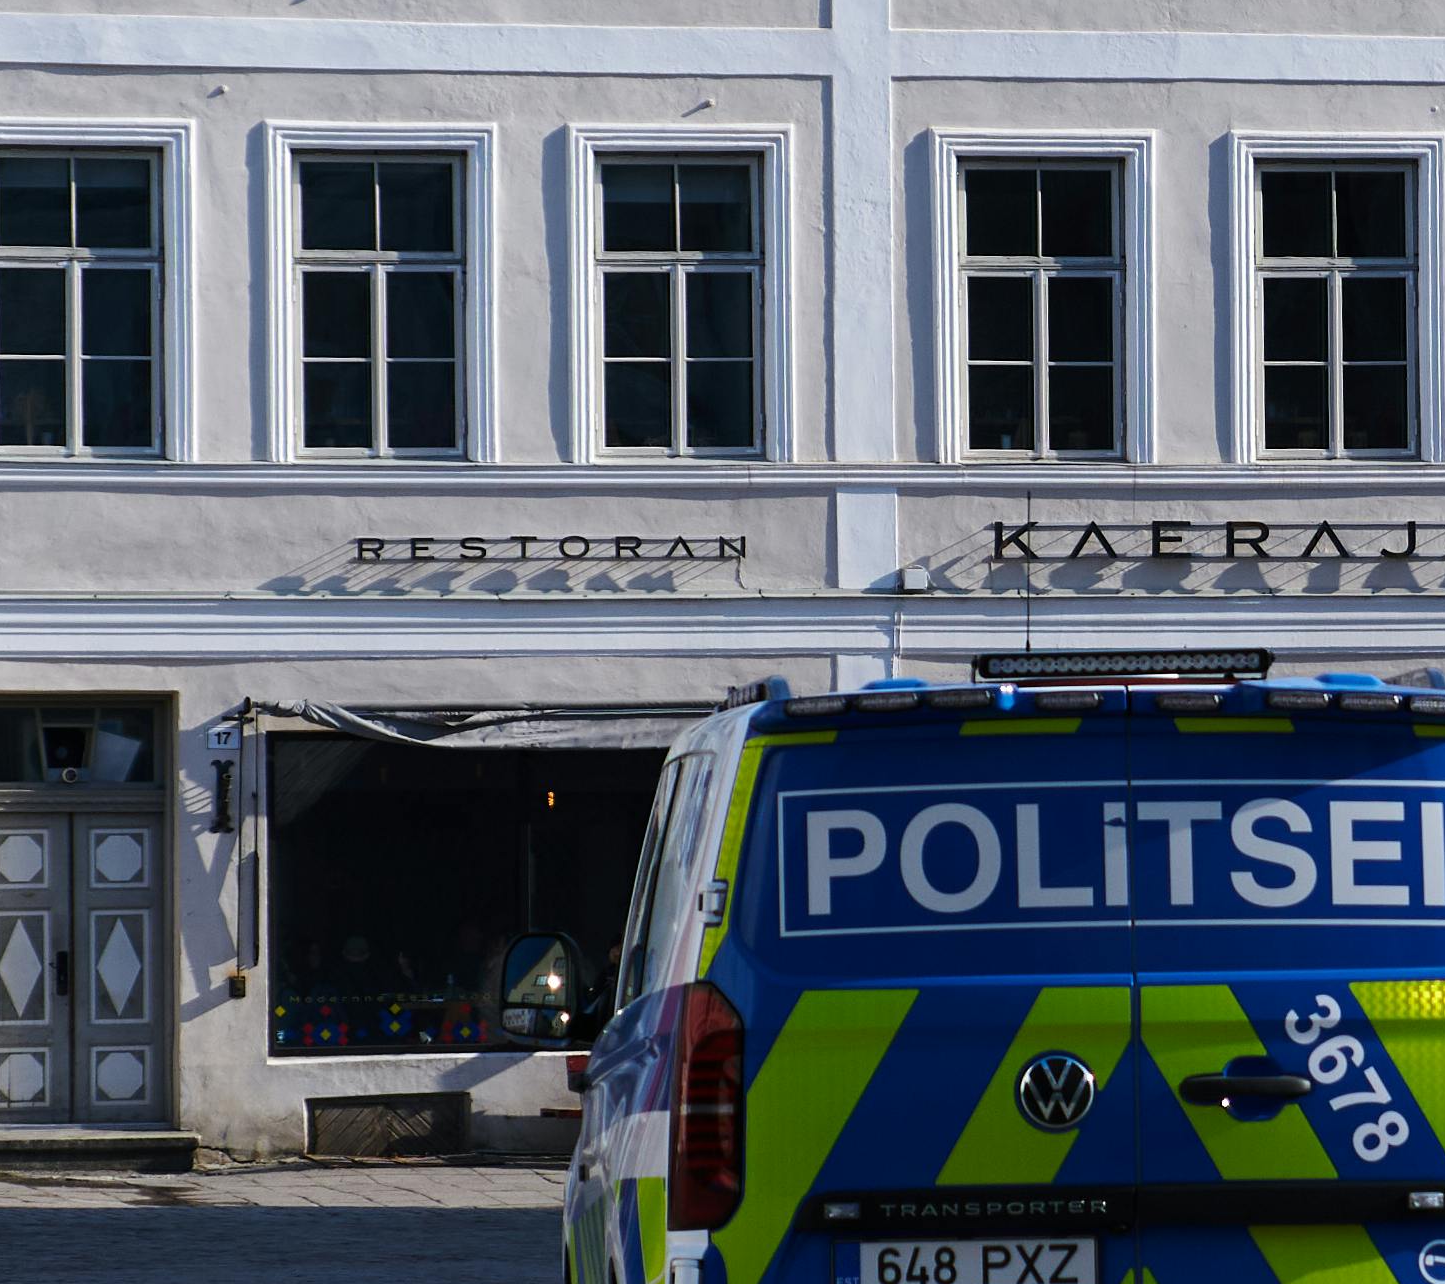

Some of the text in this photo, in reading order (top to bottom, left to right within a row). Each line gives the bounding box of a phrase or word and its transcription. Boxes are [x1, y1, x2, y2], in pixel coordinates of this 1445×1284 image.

[357, 534, 746, 562] RESTORAN
[214, 731, 232, 745] 17
[1284, 994, 1410, 1162] 3678
[880, 1200, 1107, 1217] TRANSPORTER
